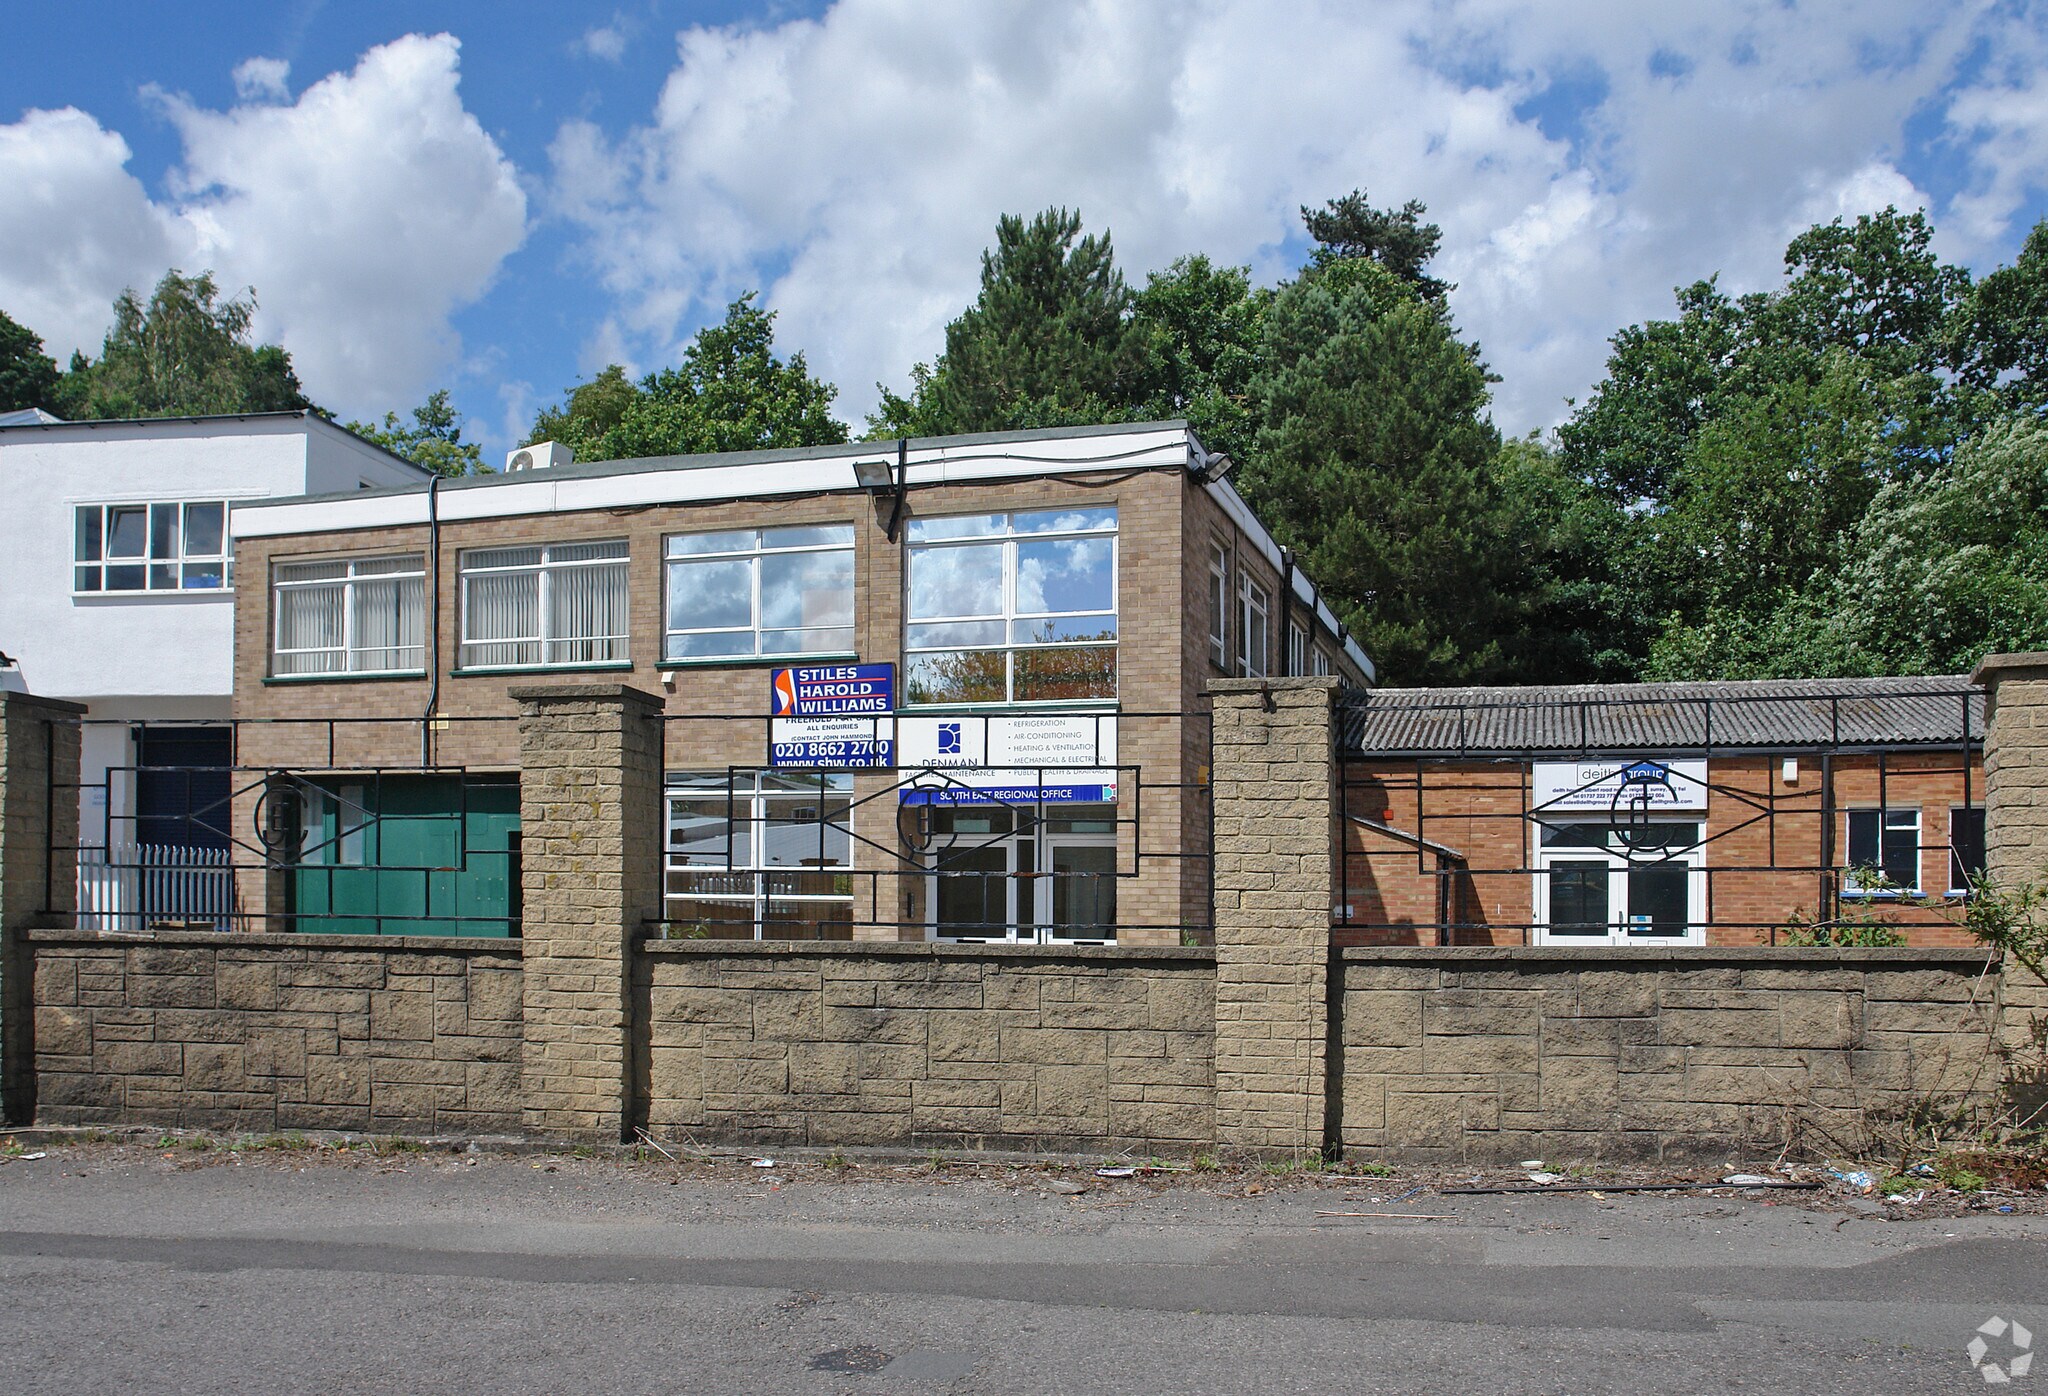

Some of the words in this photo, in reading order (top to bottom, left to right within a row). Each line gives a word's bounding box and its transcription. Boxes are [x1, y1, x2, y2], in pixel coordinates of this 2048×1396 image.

[799, 667, 857, 681] STILES
[799, 683, 872, 698] HAROLD
[800, 698, 887, 713] WILLIAMS
[822, 723, 859, 731] ENQUIRIES
[1013, 719, 1066, 728] REFRIGERATION
[1013, 731, 1082, 740] AIR-CONDITIONING
[775, 743, 804, 757] 020
[808, 742, 846, 756] 8662
[851, 740, 889, 756] 2700
[1013, 744, 1044, 752] HEATING
[1013, 756, 1059, 764] MECHANICAL
[1068, 755, 1108, 763] ELECTRIAL
[994, 790, 1039, 800] REGIONAL
[1041, 789, 1073, 798] OFFICE
